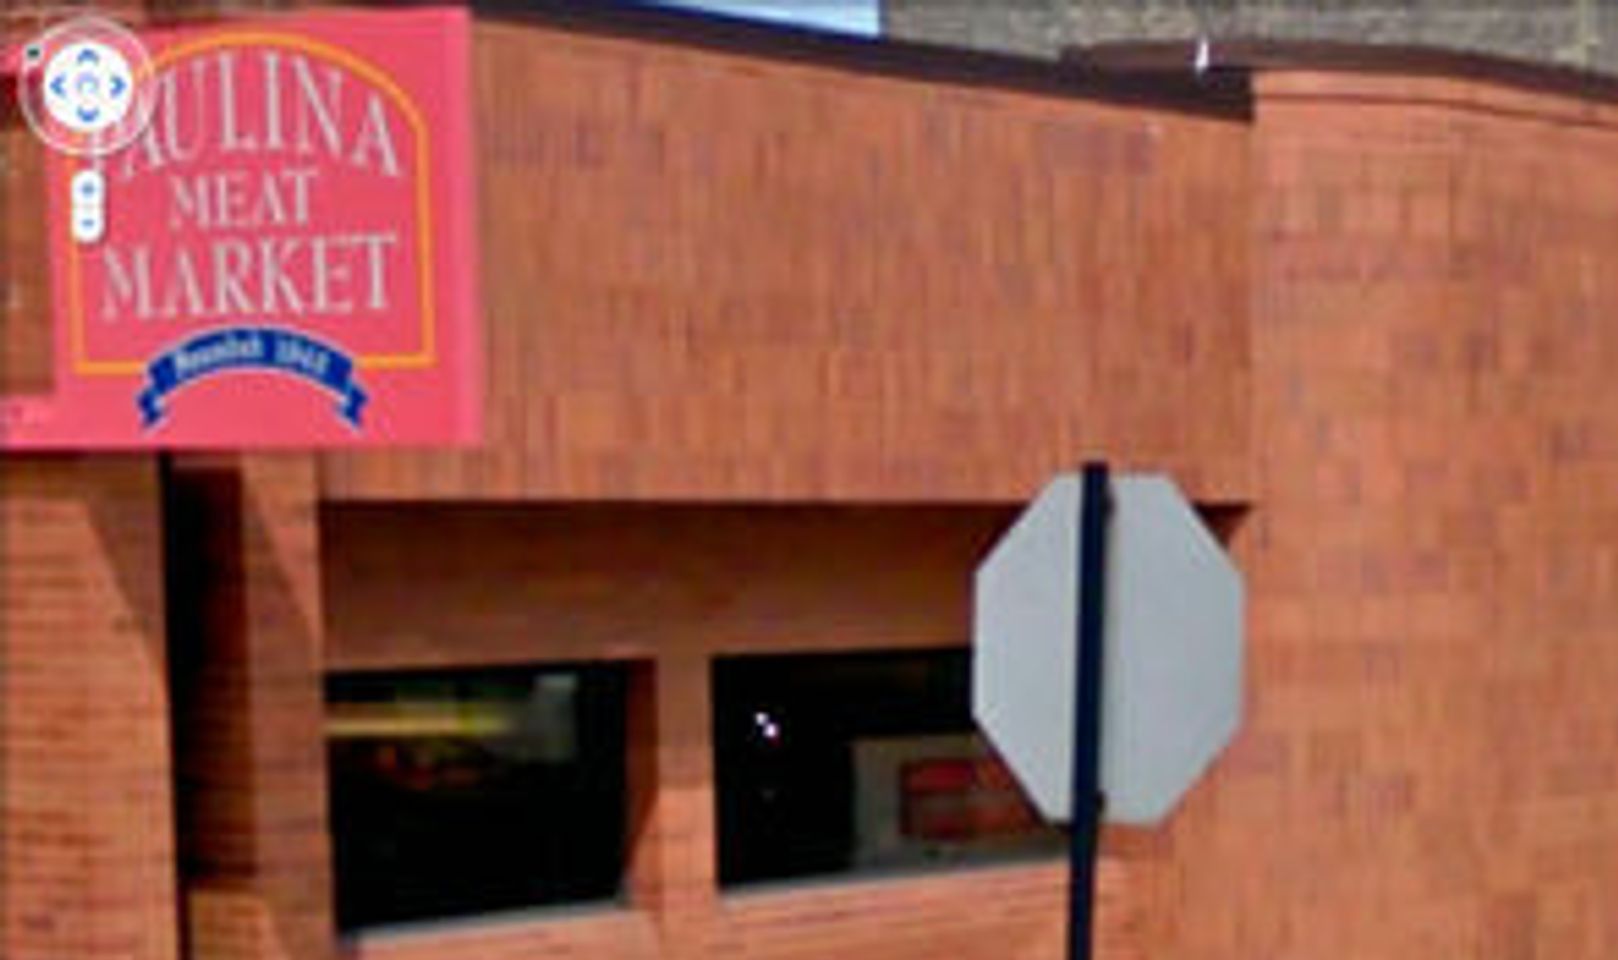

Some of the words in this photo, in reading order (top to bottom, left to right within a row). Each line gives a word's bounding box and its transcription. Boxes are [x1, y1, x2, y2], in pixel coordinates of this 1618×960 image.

[92, 53, 400, 180] AULINA
[167, 167, 319, 230] MEAT
[101, 232, 397, 318] MARKET
